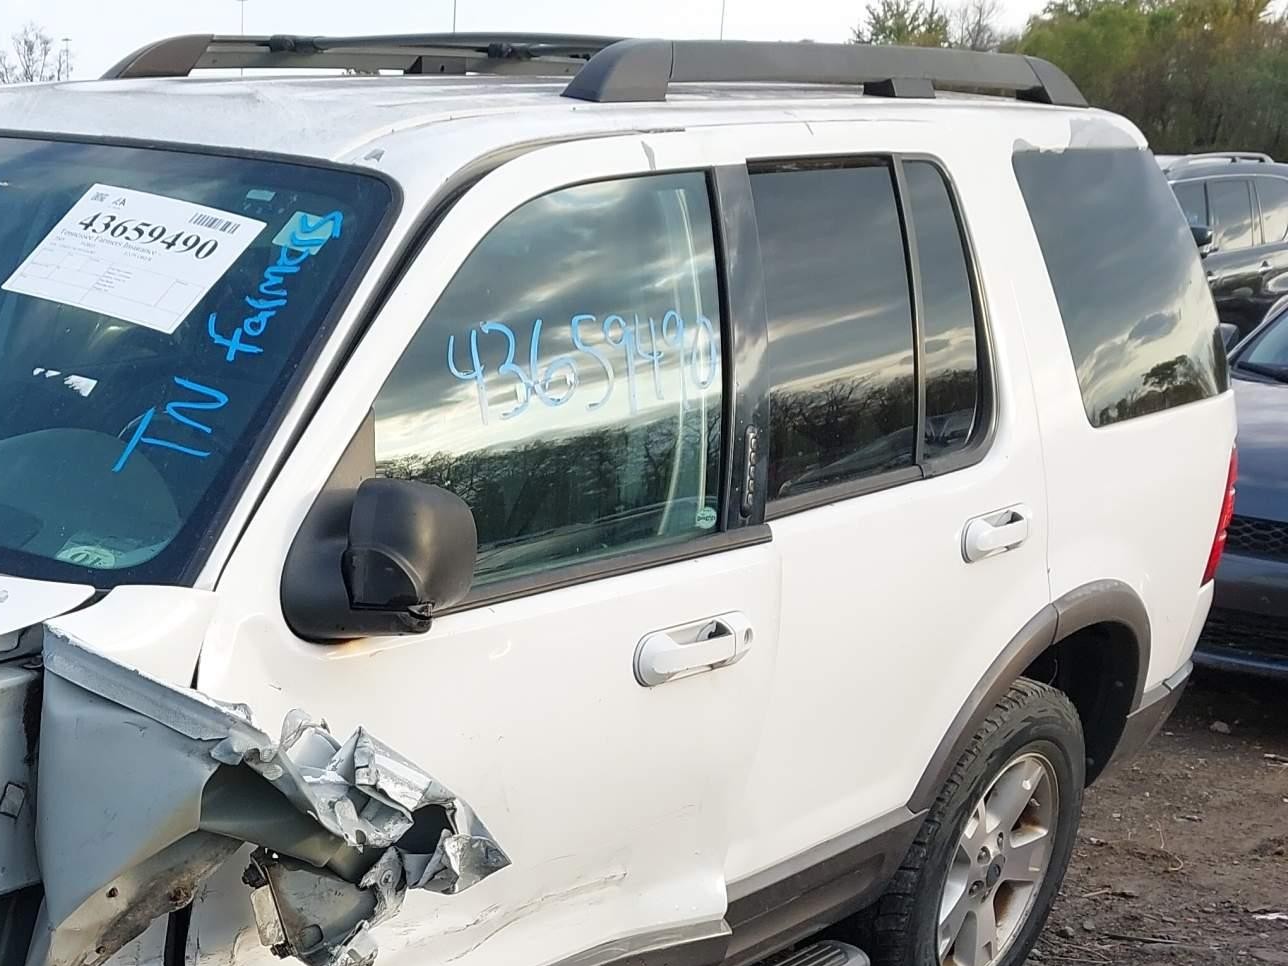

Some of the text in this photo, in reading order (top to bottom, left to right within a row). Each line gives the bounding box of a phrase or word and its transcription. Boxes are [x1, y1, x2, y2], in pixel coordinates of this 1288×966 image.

[78, 211, 219, 260] 43659490
[447, 309, 717, 427] 43659490
[112, 375, 229, 473] TN
